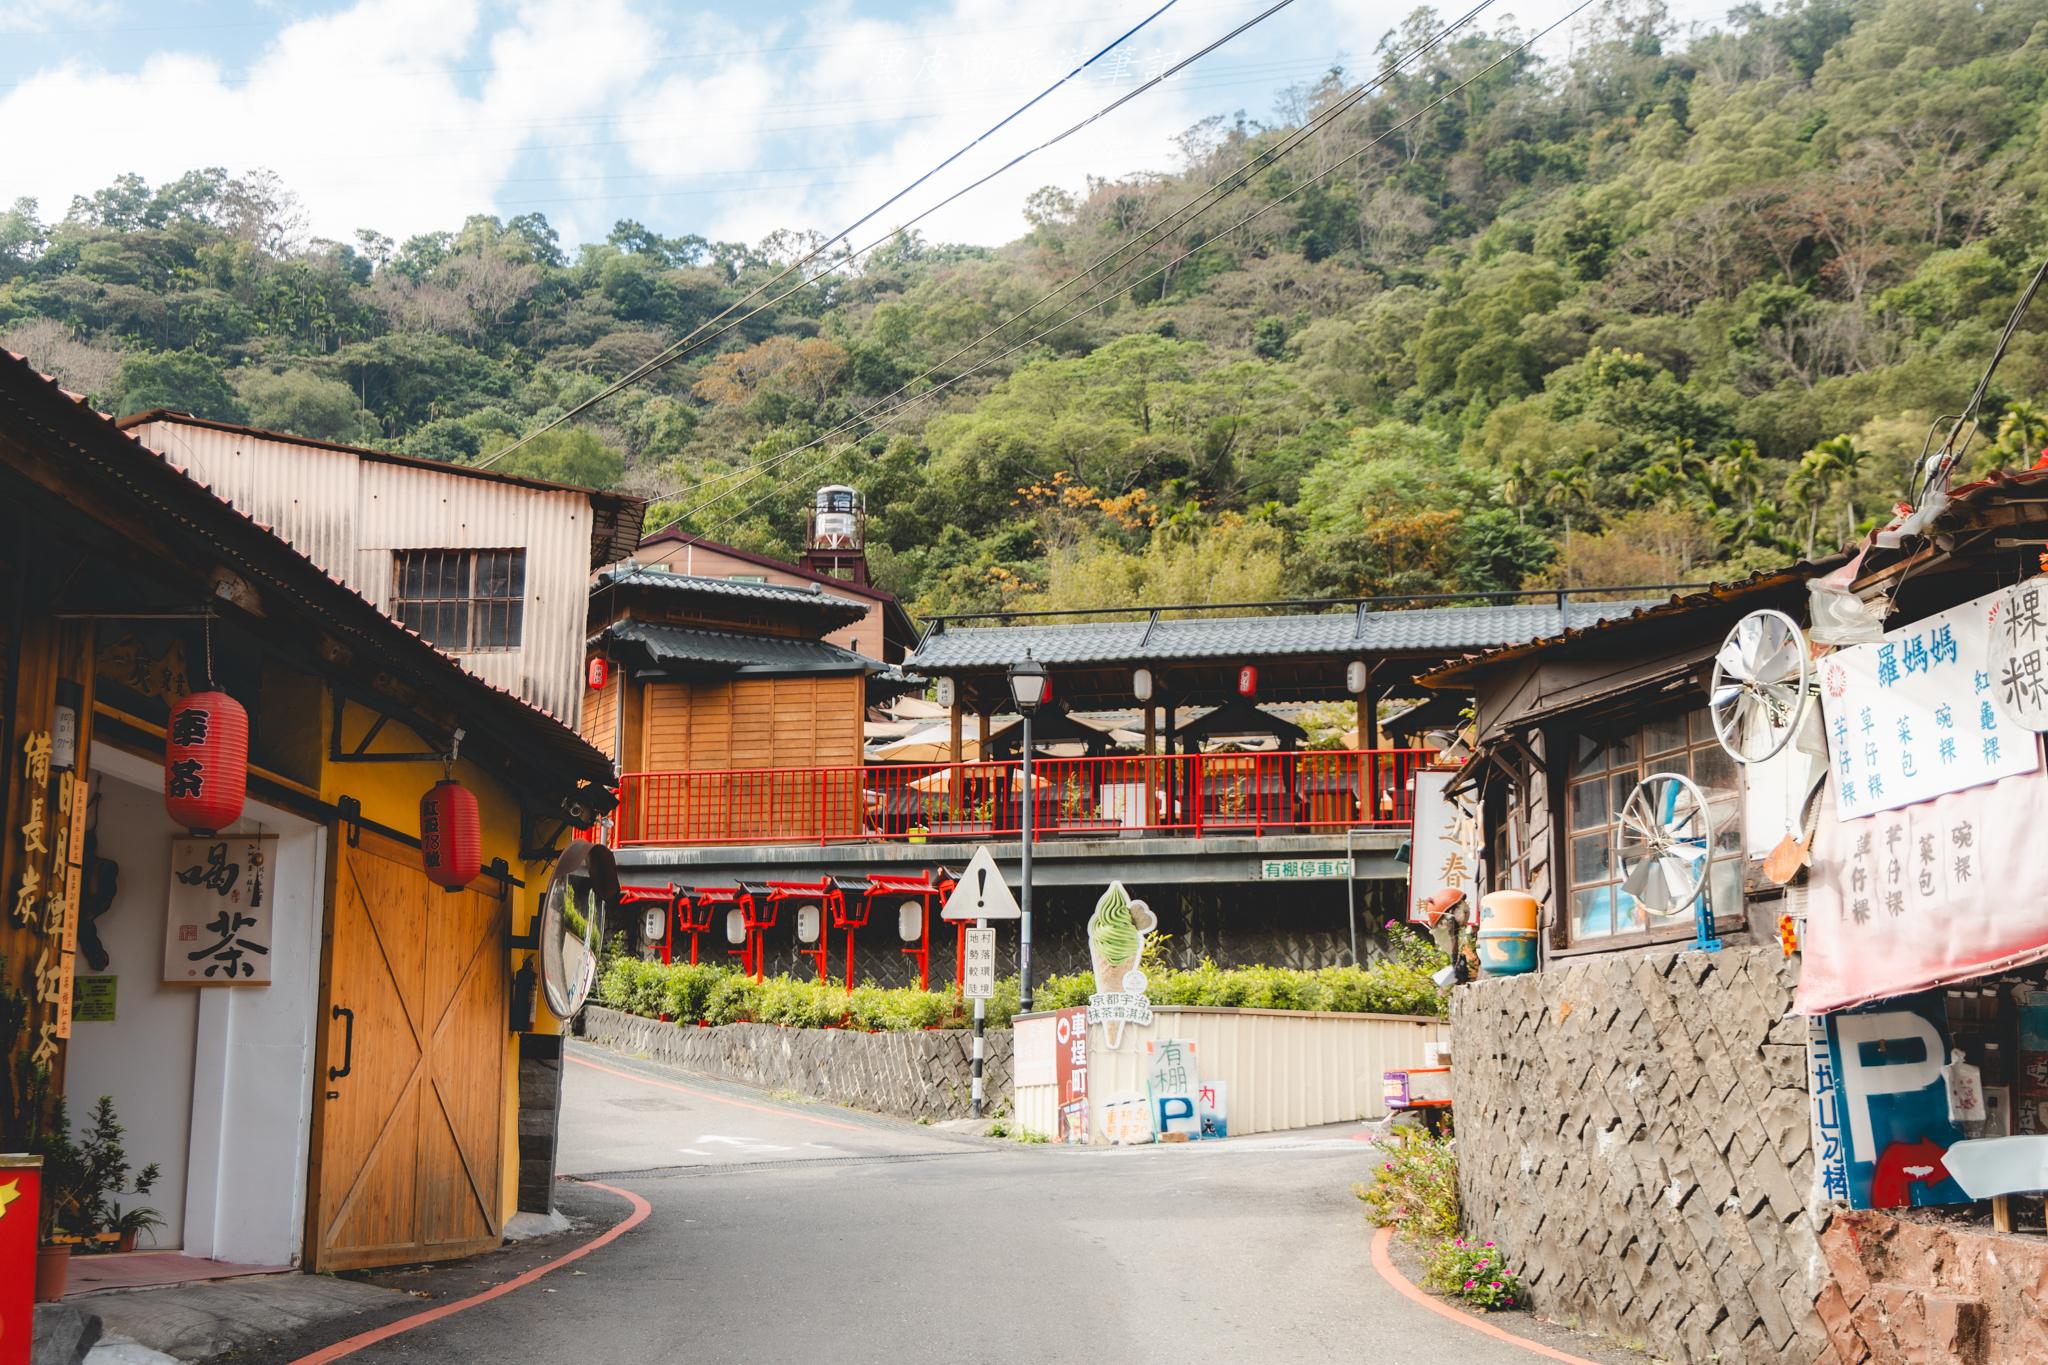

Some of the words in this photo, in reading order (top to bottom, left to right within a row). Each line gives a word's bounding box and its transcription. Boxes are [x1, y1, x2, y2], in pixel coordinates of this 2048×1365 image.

[1877, 623, 1957, 689] 羅媽媽
[1897, 714, 1917, 777] 菜包
[1935, 702, 1957, 765] 碗粿
[1974, 670, 2001, 766] 紅龜粿
[171, 708, 210, 799] 奉茶
[1834, 716, 1857, 807] 芋仔粿
[1860, 706, 1884, 799] 草仔粿
[1265, 861, 1351, 878] 有棚停車位
[1852, 831, 1873, 925] 草仔粿
[1885, 824, 1904, 917] 芋仔粿
[1919, 833, 1936, 896] 菜包
[1951, 820, 1973, 884] 碗粿
[175, 842, 269, 978] 喝茶
[968, 933, 979, 993] 地勢較陡
[980, 933, 991, 993] 村落環境
[1089, 1007, 1150, 1021] 抹茶霜淇淋
[1092, 994, 1148, 1008] 京都宇治
[1071, 1012, 1087, 1093] 車埕町
[1155, 1040, 1187, 1093] 有棚
[1159, 1097, 1194, 1132] P
[1836, 1011, 1945, 1162] P
